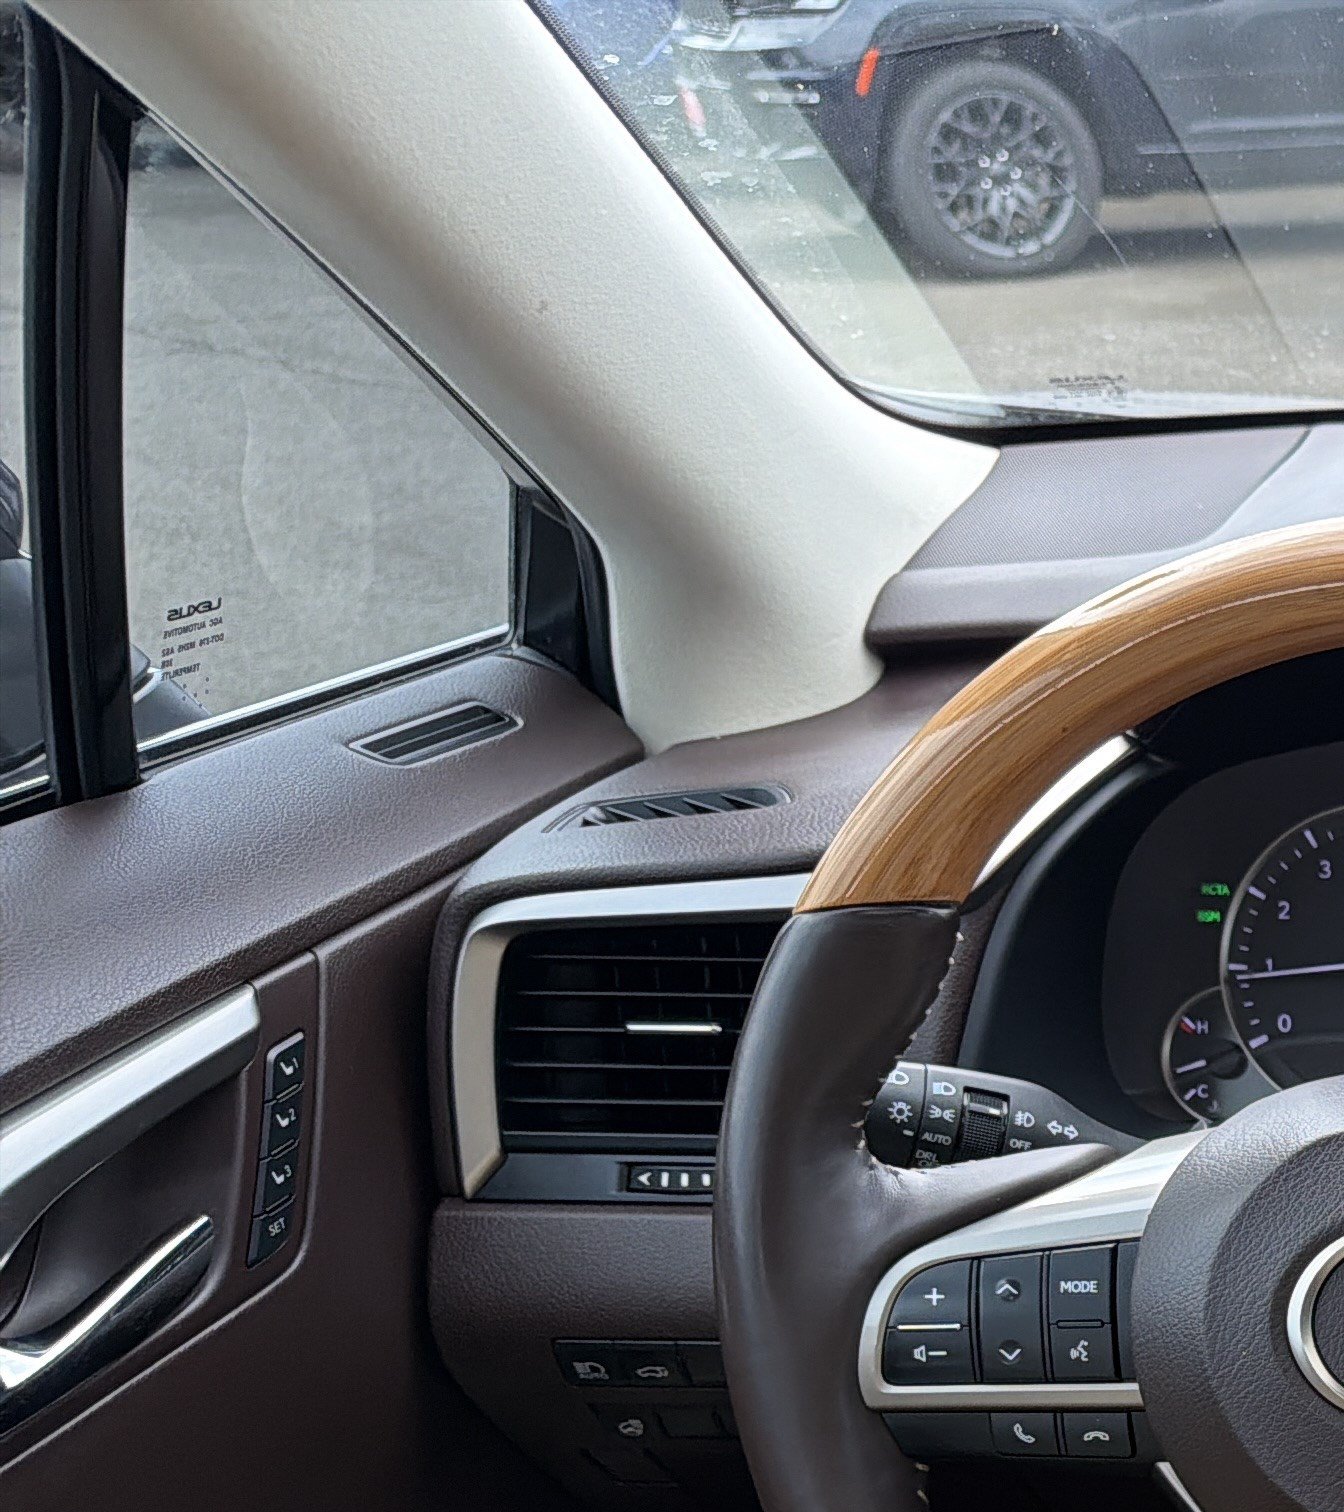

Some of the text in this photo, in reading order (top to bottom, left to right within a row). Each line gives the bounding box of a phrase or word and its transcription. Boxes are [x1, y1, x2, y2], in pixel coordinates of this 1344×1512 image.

[1317, 859, 1332, 880] 3
[1277, 901, 1292, 921] 2
[1196, 1019, 1210, 1035] H
[1276, 1013, 1292, 1034] 0
[291, 1057, 299, 1069] 1
[1197, 1083, 1210, 1099] C
[288, 1108, 297, 1121] 2
[921, 1131, 952, 1146] AUTO
[1009, 1138, 1033, 1150] OFF
[914, 1149, 938, 1163] DRL
[283, 1164, 292, 1178] 3
[267, 1217, 286, 1238] SET
[1060, 1281, 1098, 1293] MODE
